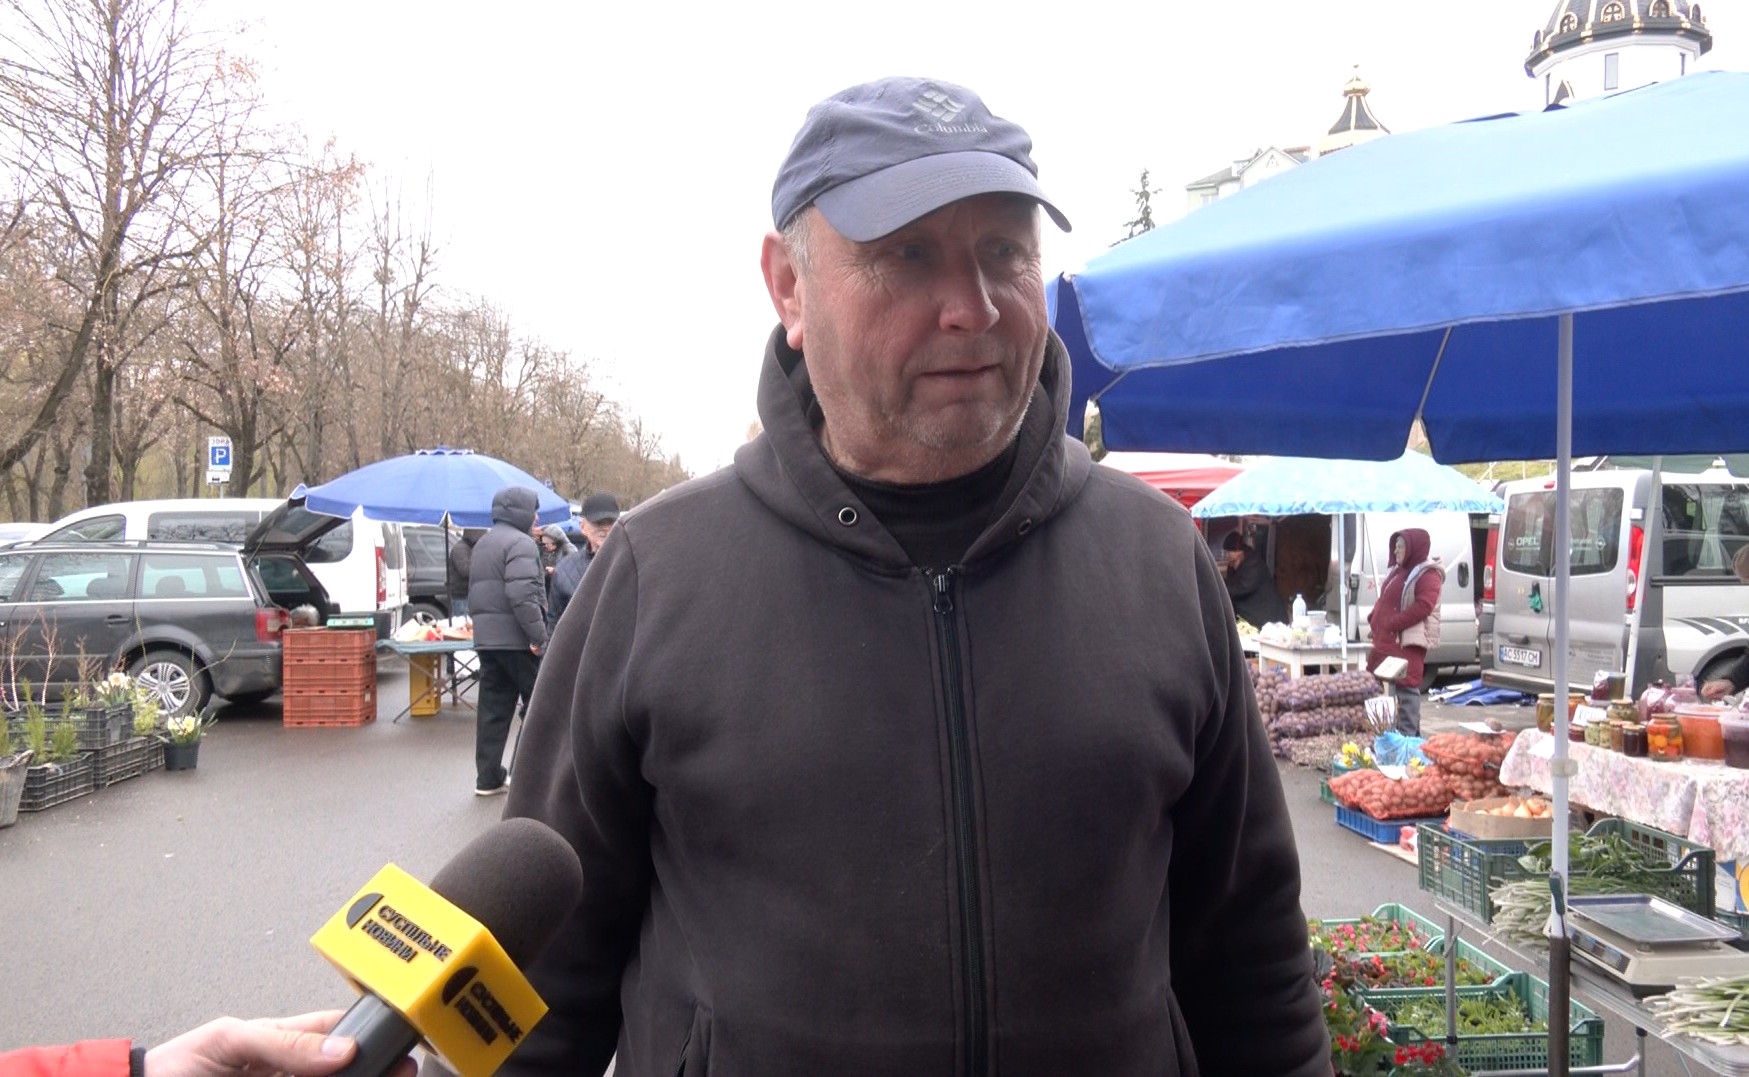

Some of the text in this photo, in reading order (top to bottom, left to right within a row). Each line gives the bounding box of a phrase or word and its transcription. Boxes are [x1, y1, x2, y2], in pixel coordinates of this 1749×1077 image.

[913, 121, 988, 134] Columbia
[215, 448, 227, 464] P
[1516, 536, 1539, 546] OPEL
[361, 918, 419, 963] НОВИНИ
[378, 904, 453, 962] СУСПІЛЬНЕ
[470, 981, 524, 1044] СУСЬНЕ
